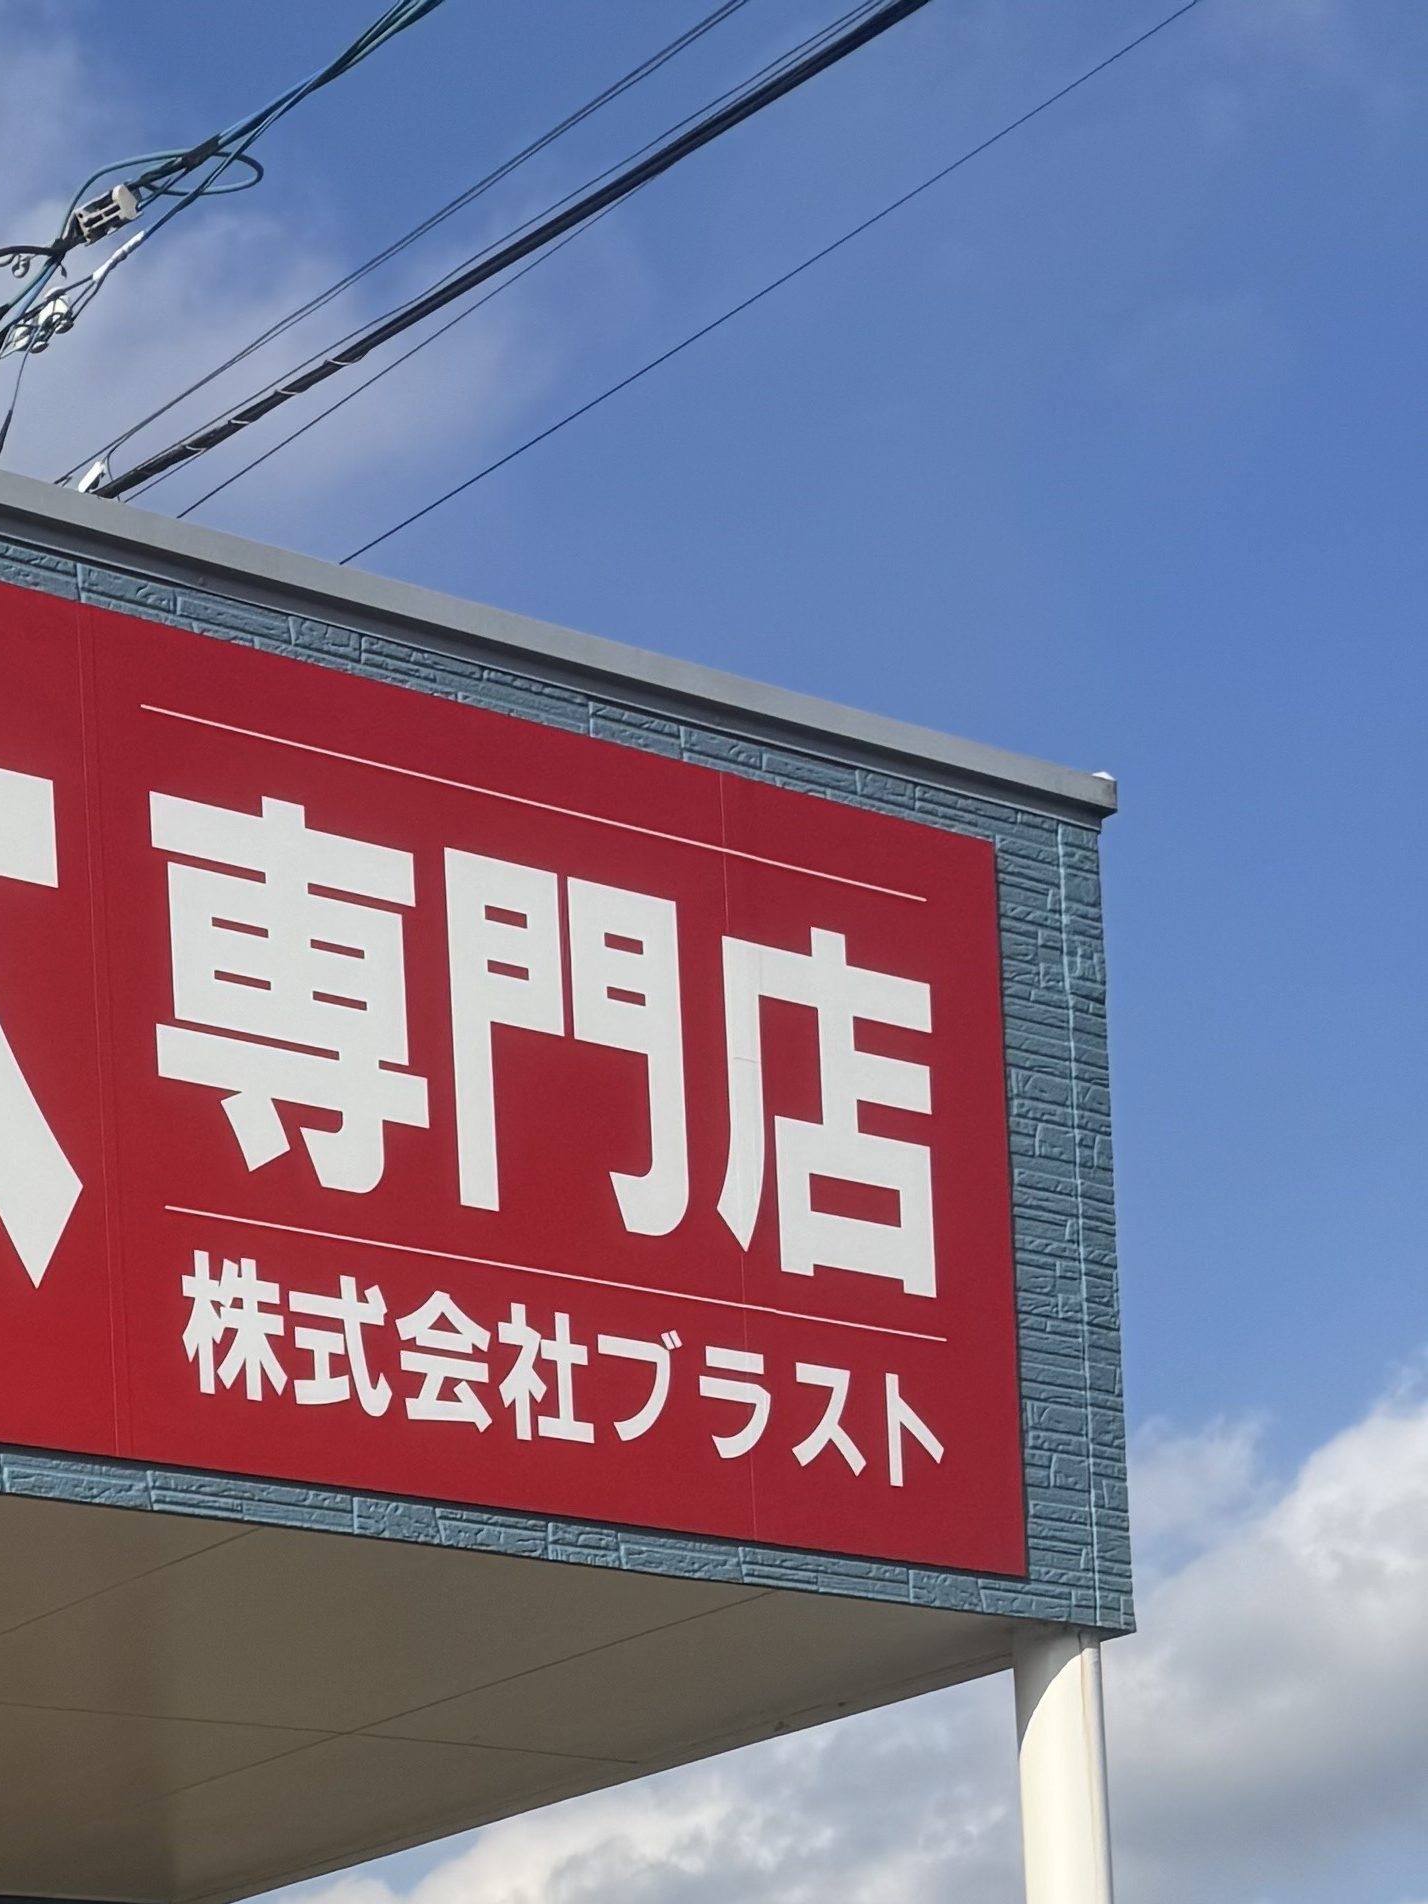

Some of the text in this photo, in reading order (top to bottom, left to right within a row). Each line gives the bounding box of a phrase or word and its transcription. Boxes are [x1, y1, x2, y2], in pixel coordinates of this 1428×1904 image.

[149, 791, 937, 1299] 専門店
[181, 1249, 945, 1487] 株式会社ブラスト
